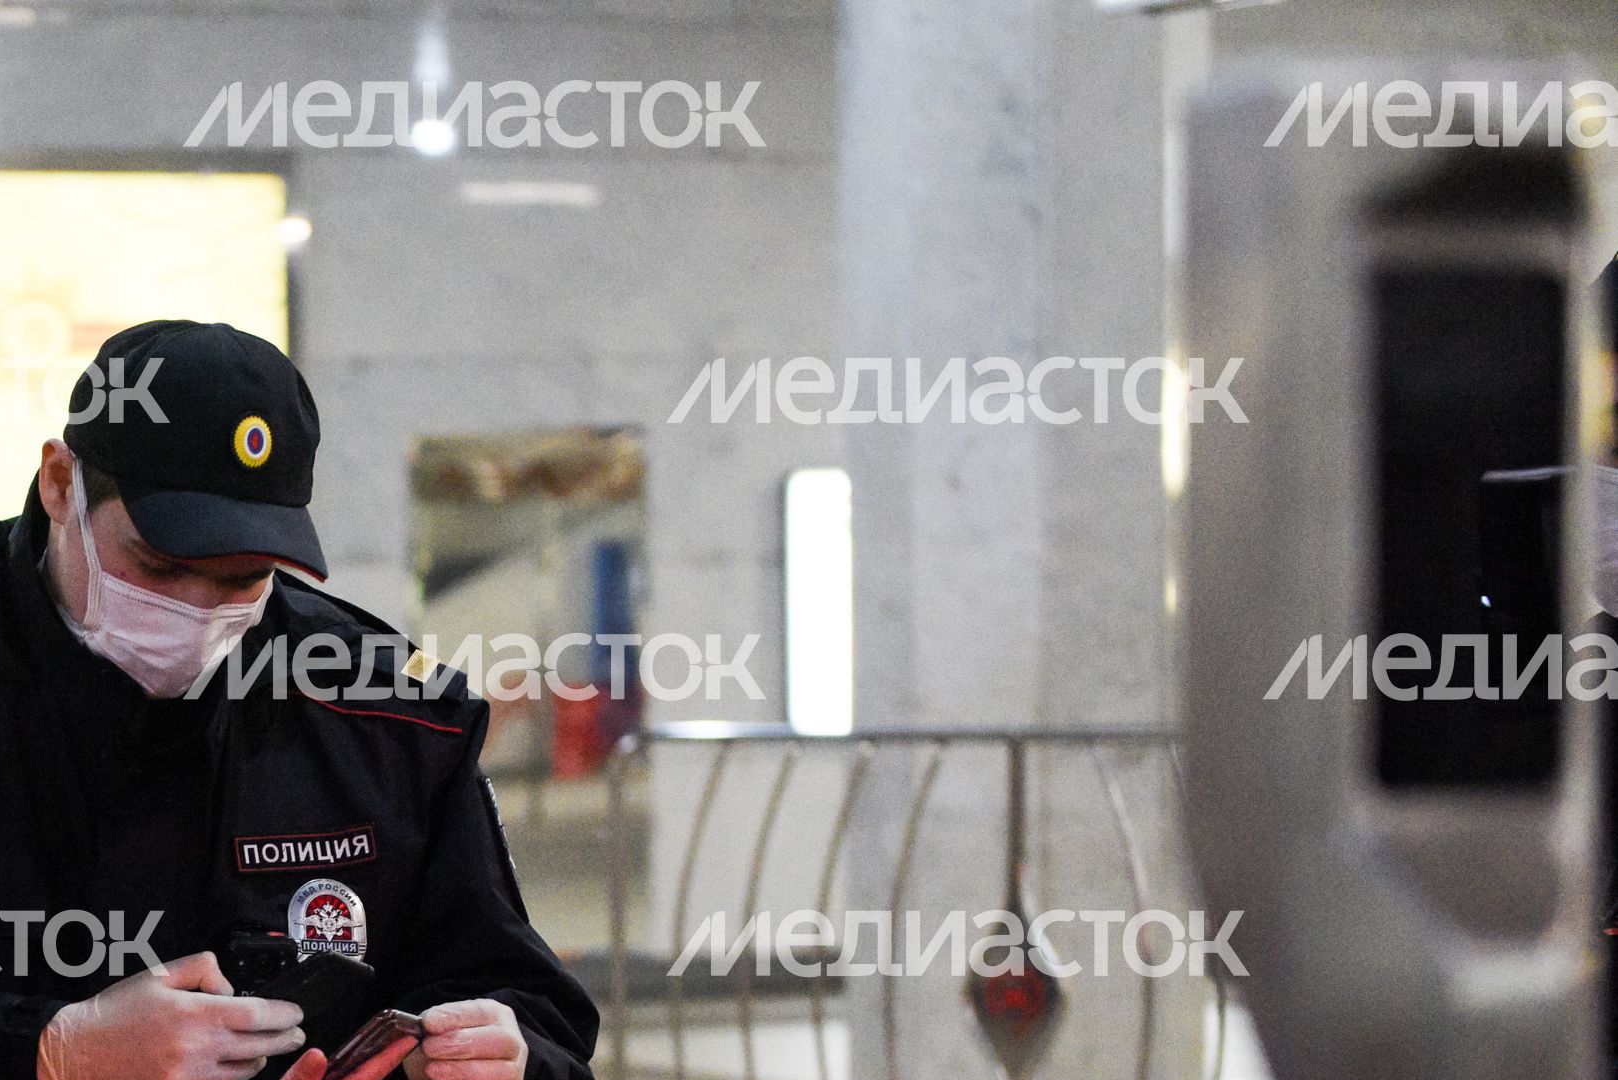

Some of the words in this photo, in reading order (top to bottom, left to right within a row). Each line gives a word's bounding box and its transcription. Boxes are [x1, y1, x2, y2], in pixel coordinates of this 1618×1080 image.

[243, 834, 370, 864] ПОЛИЦИЯ
[297, 886, 317, 904] МВД
[318, 883, 357, 907] РОССИИ
[302, 941, 357, 953] ПОЛИЦИЯ
